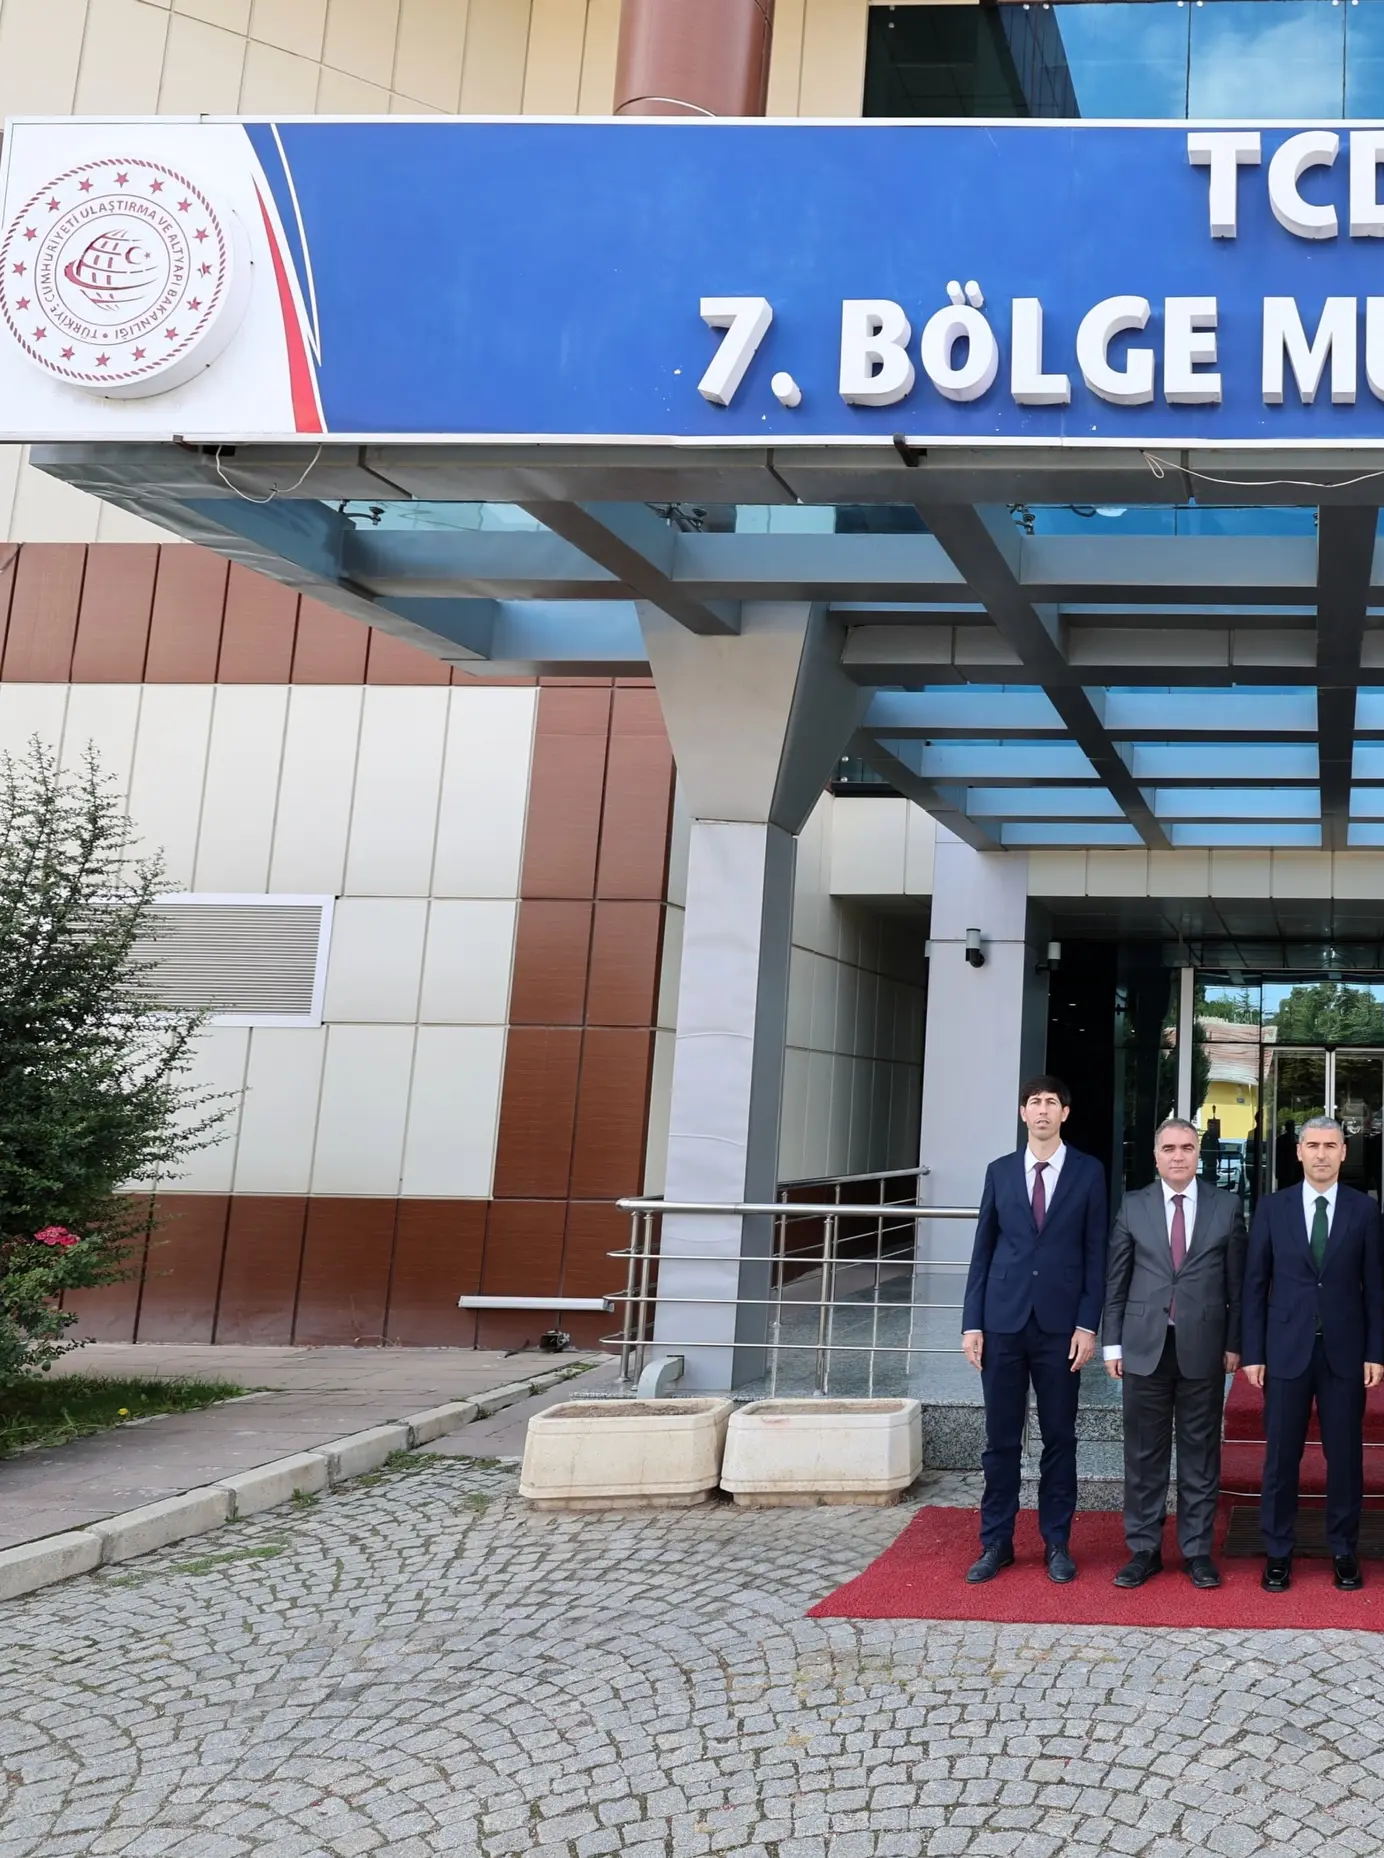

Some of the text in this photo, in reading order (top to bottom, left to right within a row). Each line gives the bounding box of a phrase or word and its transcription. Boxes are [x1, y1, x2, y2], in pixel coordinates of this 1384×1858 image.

[41, 200, 185, 340] TÜRKİYE CUMHURİYETİ ULAŞTIRMA VE ALTYAPI BAKANLIĞI
[697, 296, 803, 407] 7.
[838, 279, 1222, 407] BÖLGE
